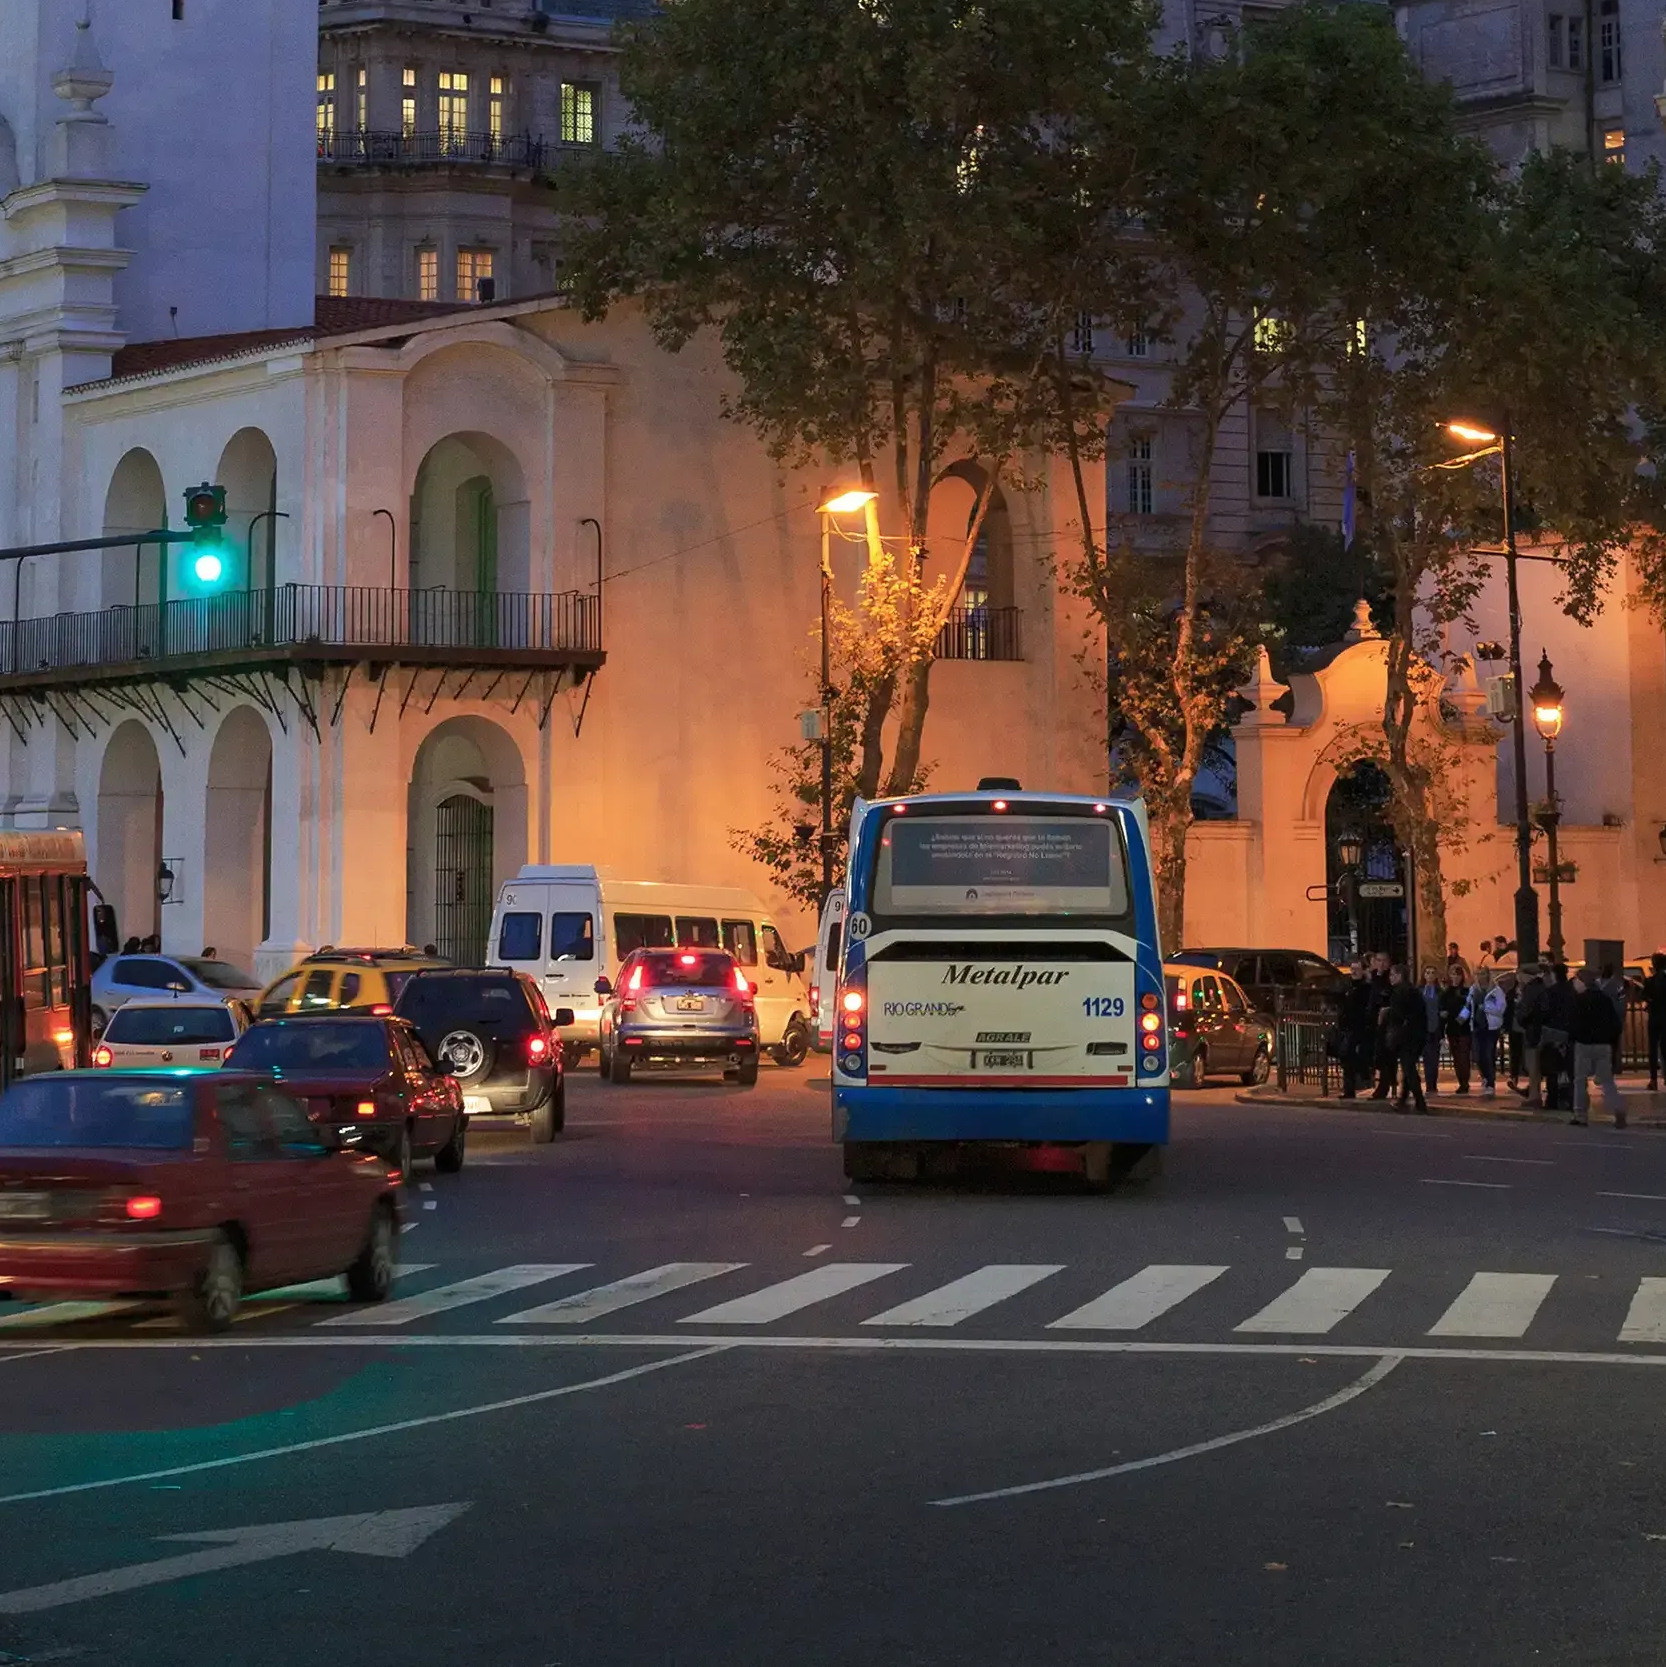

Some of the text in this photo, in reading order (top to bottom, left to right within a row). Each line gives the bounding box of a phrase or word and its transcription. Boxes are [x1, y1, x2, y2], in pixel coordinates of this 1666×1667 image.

[851, 917, 868, 934] 60
[941, 964, 1069, 990] Metalpar
[884, 1002, 904, 1016] RIO
[1082, 997, 1125, 1017] 1129
[977, 1033, 1030, 1042] AGRALE
